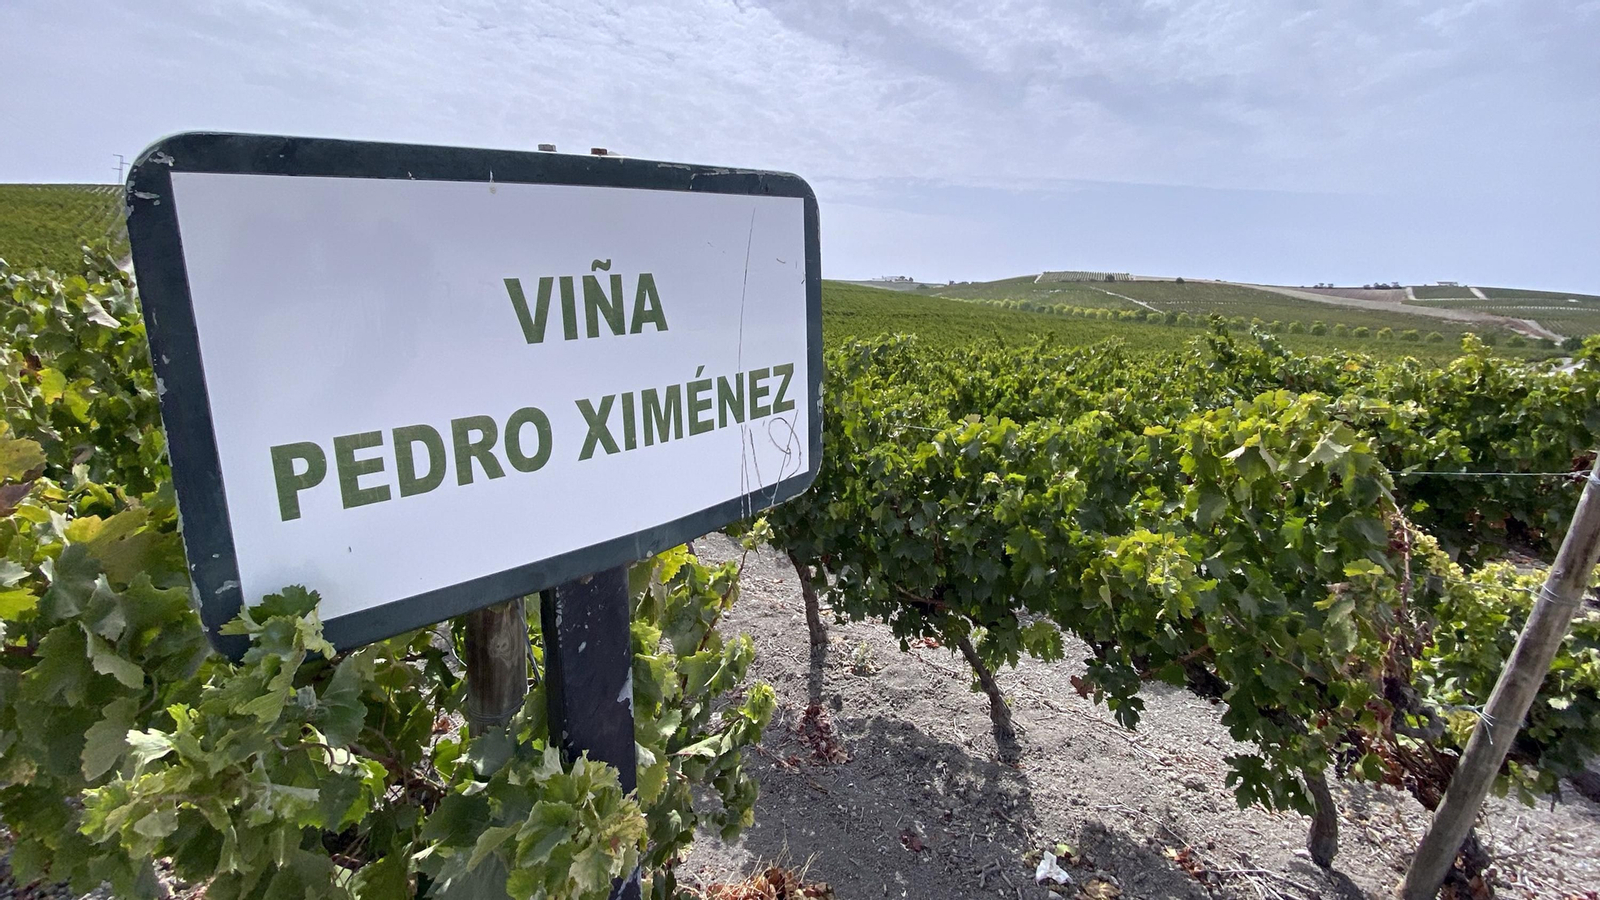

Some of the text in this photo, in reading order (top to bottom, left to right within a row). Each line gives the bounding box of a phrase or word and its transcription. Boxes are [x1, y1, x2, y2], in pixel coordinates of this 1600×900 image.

[503, 258, 669, 345] VIÑA
[269, 362, 796, 522] PEDRO XIMÉNEZ
